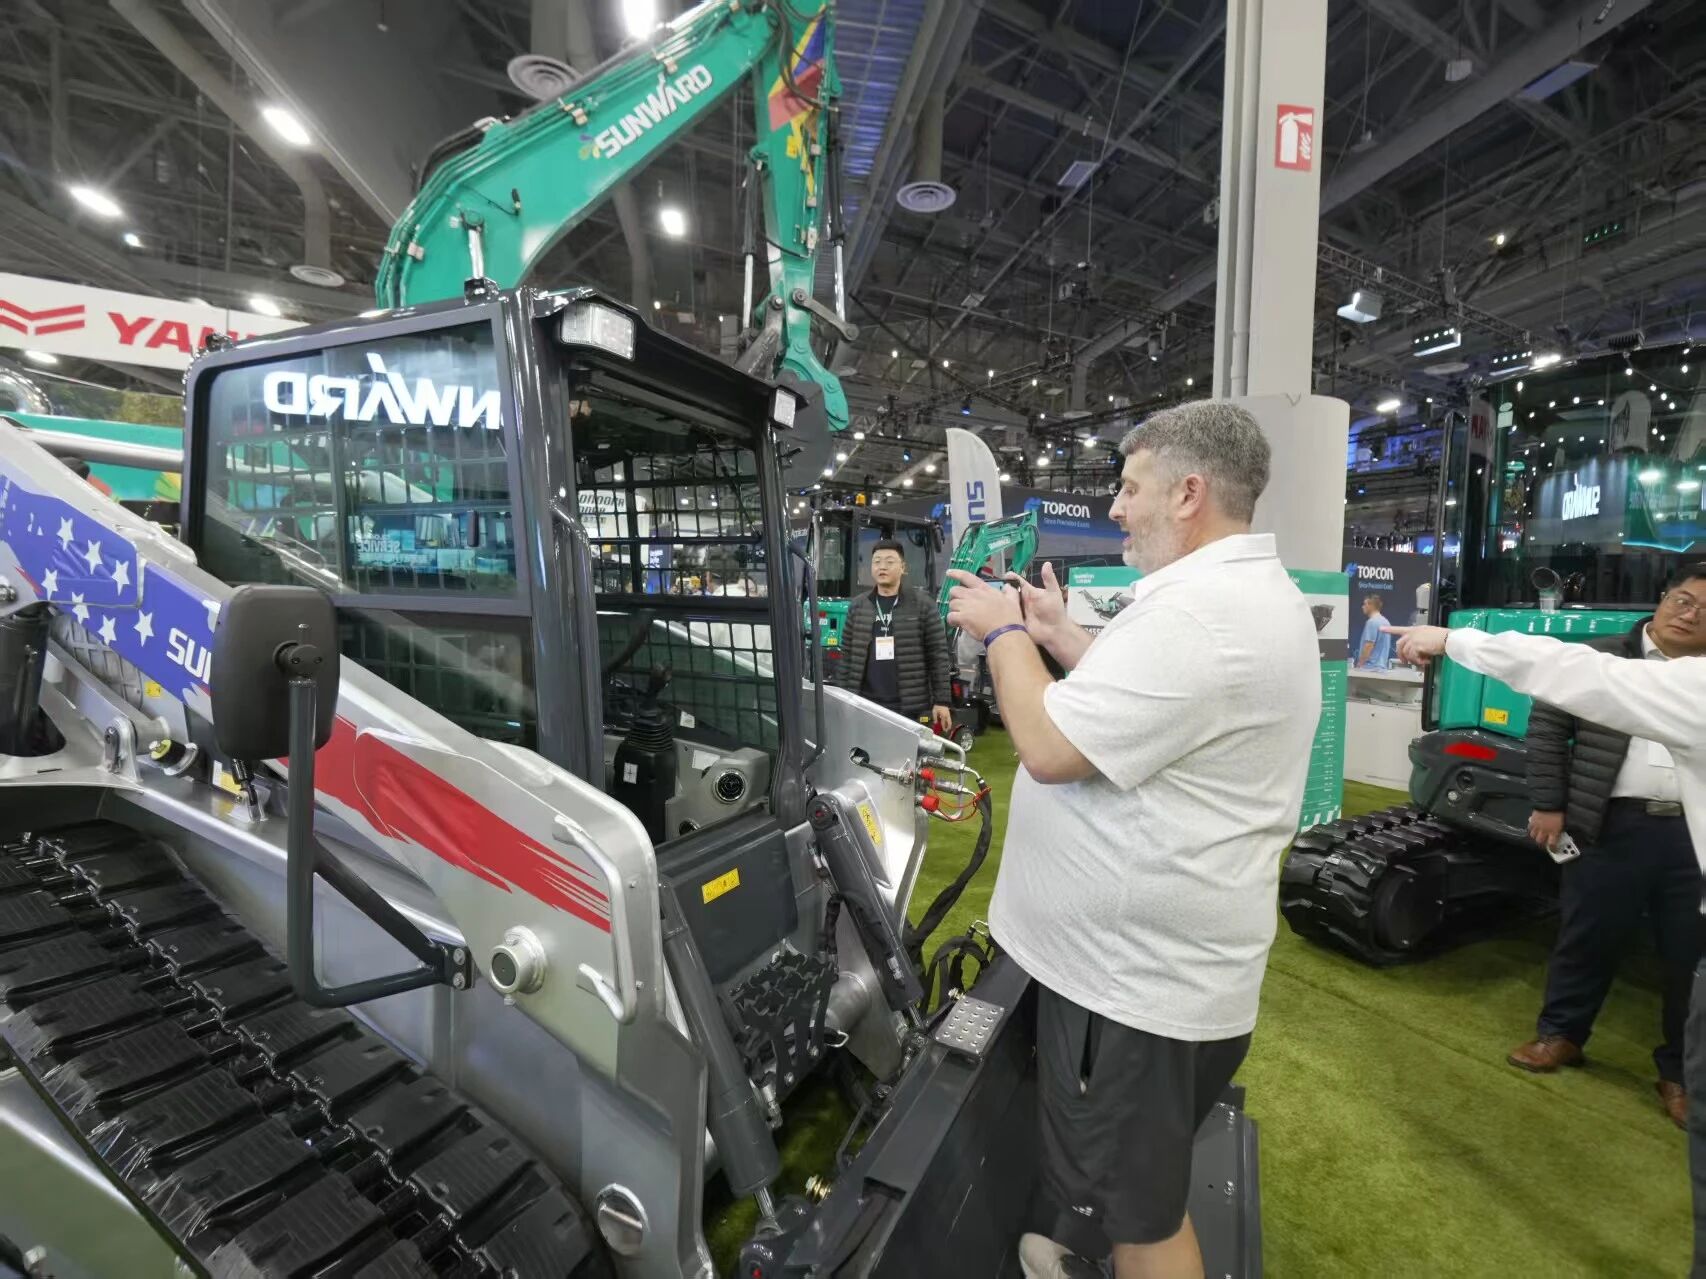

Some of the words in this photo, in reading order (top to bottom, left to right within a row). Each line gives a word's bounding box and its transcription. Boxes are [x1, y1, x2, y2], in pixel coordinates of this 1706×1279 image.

[594, 64, 713, 159] SUNWARD
[1041, 500, 1091, 519] TOPCON
[1357, 565, 1394, 580] TOPCON
